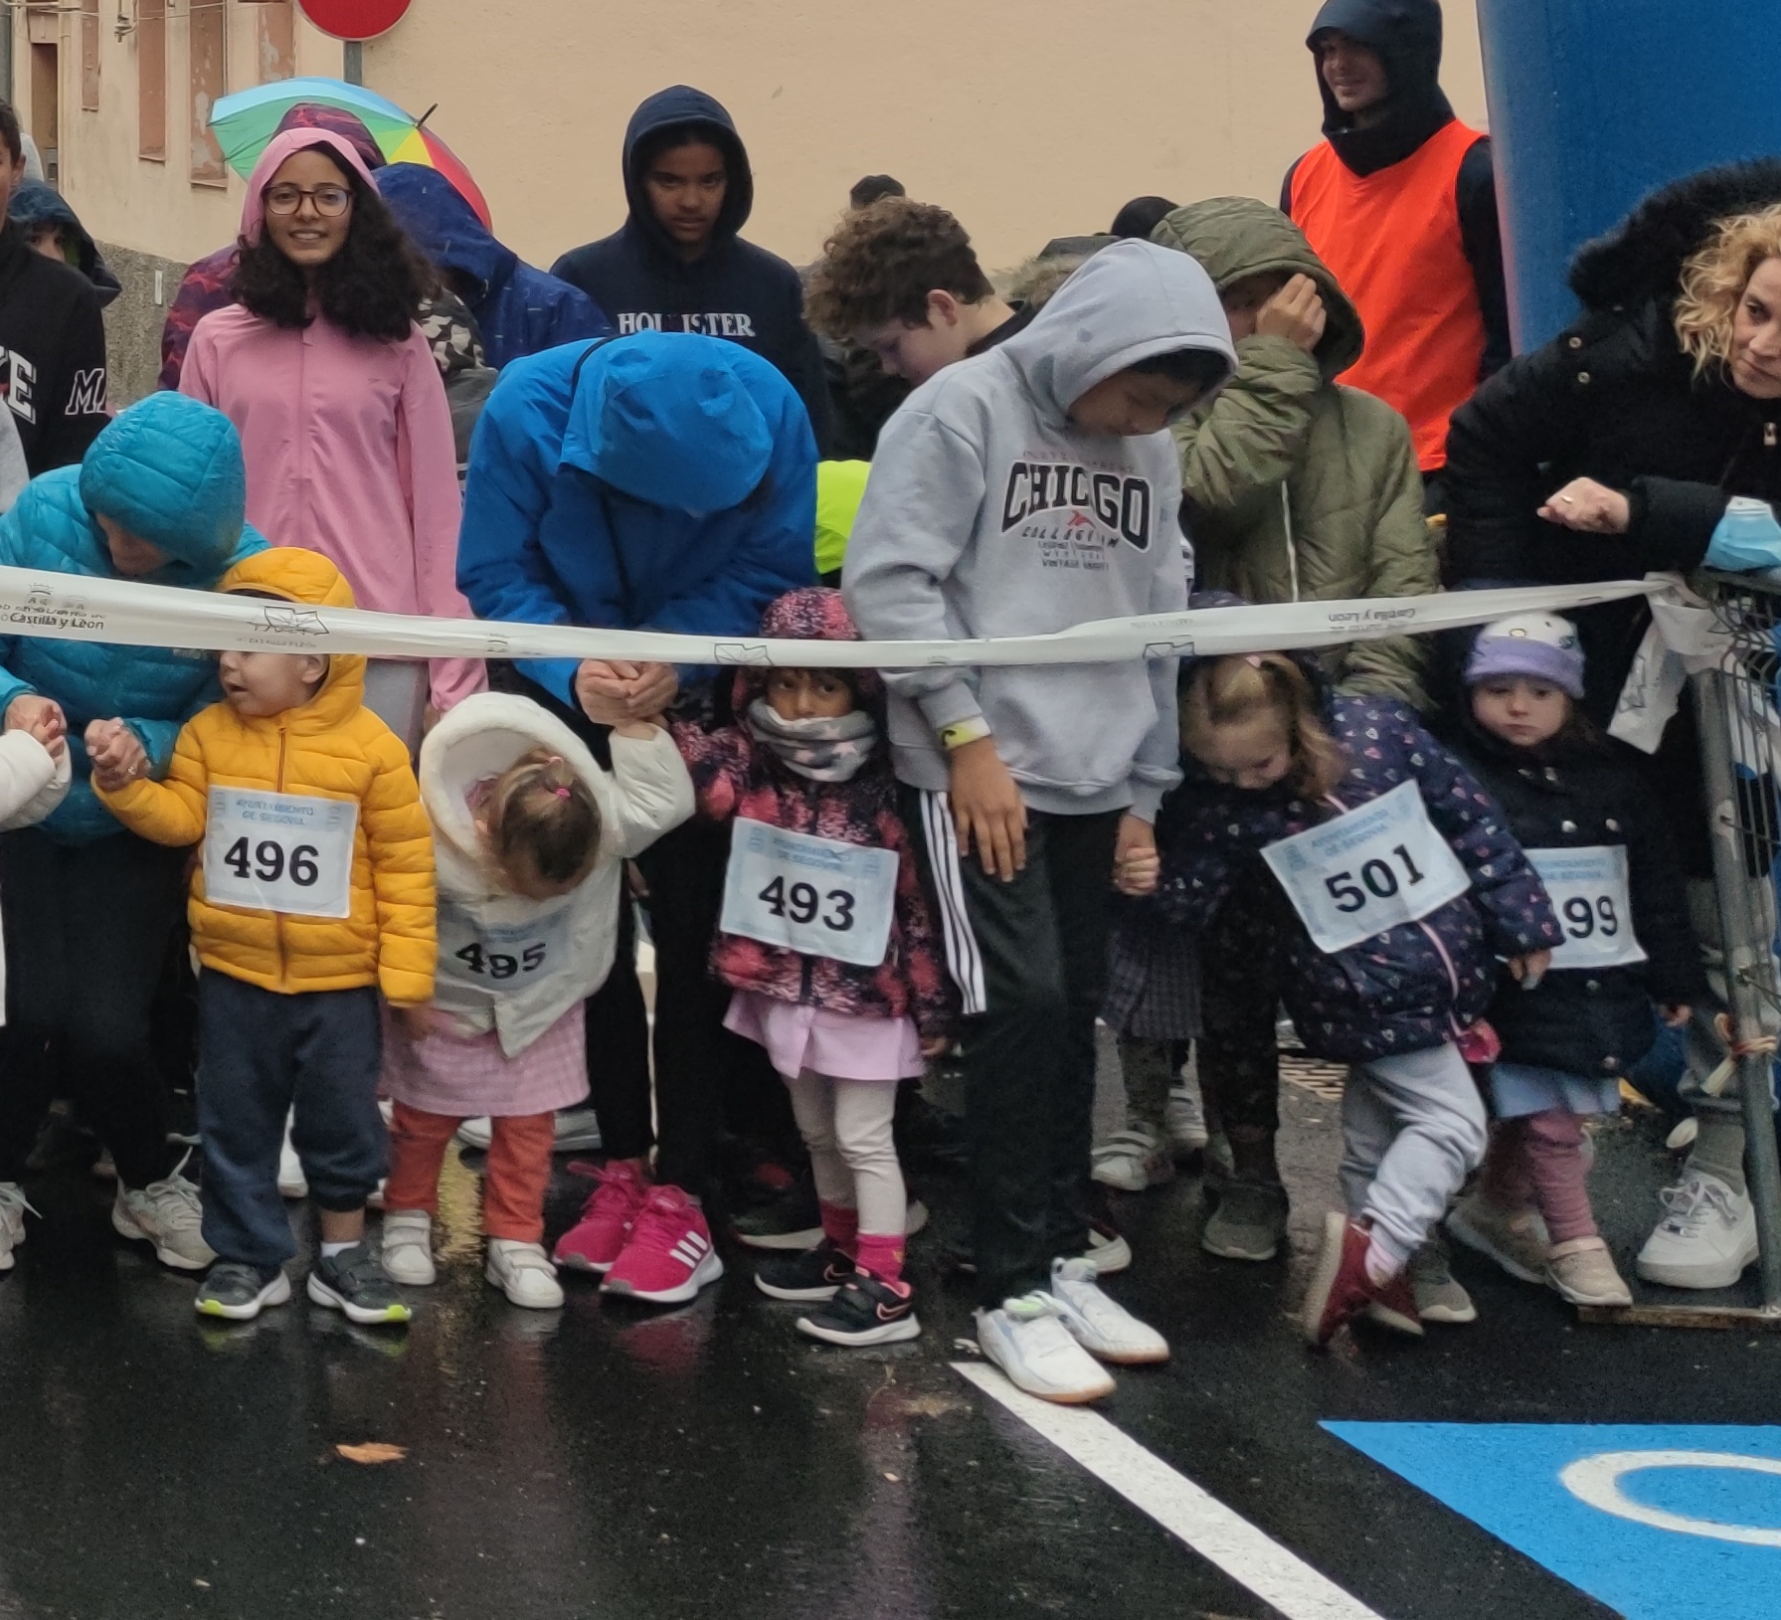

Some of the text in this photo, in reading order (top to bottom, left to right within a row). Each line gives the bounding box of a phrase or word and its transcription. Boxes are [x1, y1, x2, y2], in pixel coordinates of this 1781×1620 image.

[617, 312, 756, 337] HOLISTER
[1001, 461, 1152, 552] CHICGO
[224, 836, 319, 887] 496
[1324, 843, 1425, 913] 501
[758, 875, 855, 932] 493
[1562, 895, 1618, 939] 99
[455, 943, 546, 979] 495
